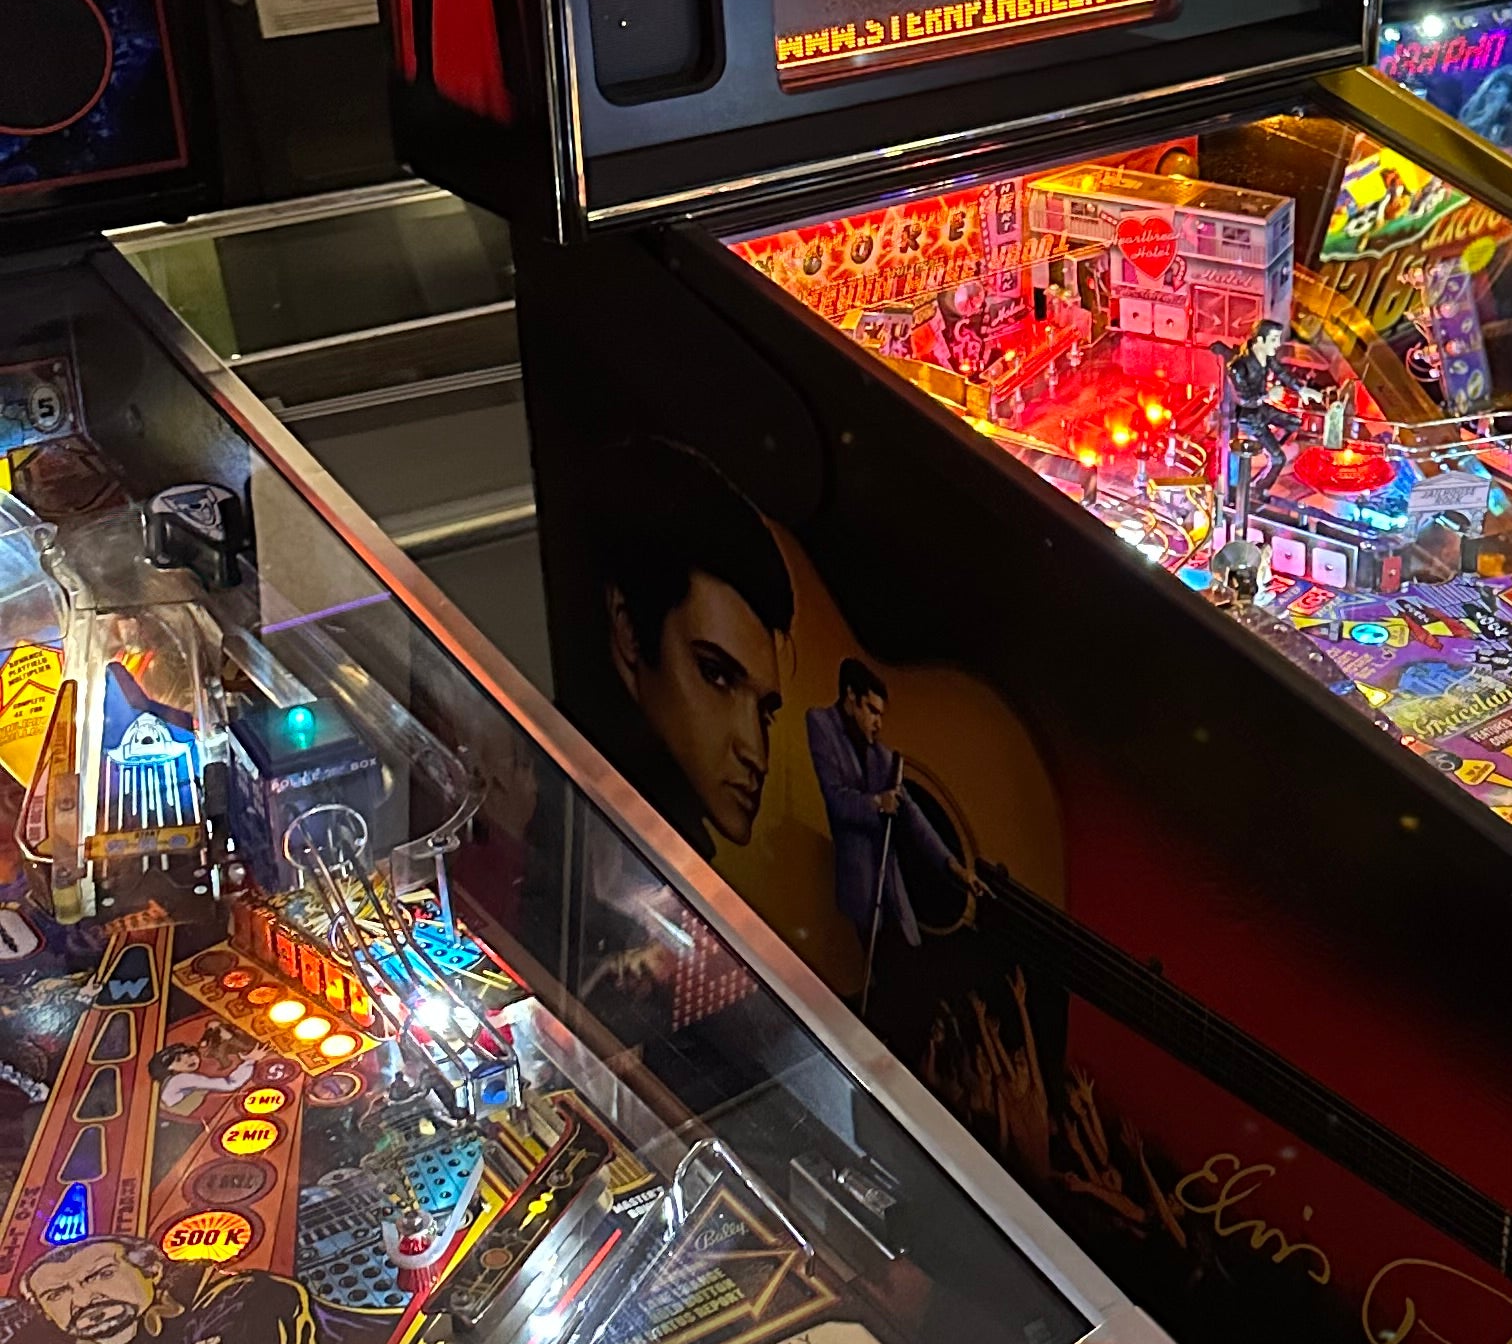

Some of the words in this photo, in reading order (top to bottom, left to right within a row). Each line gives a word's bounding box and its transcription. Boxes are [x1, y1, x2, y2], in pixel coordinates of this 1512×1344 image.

[349, 756, 378, 772] BOX
[226, 1130, 240, 1142] 2
[242, 1128, 272, 1142] MIL
[1175, 1154, 1330, 1285] Elvis
[170, 1228, 220, 1247] 500
[223, 1228, 247, 1246] K
[694, 1222, 748, 1250] Bally
[694, 1287, 746, 1317] REPORT
